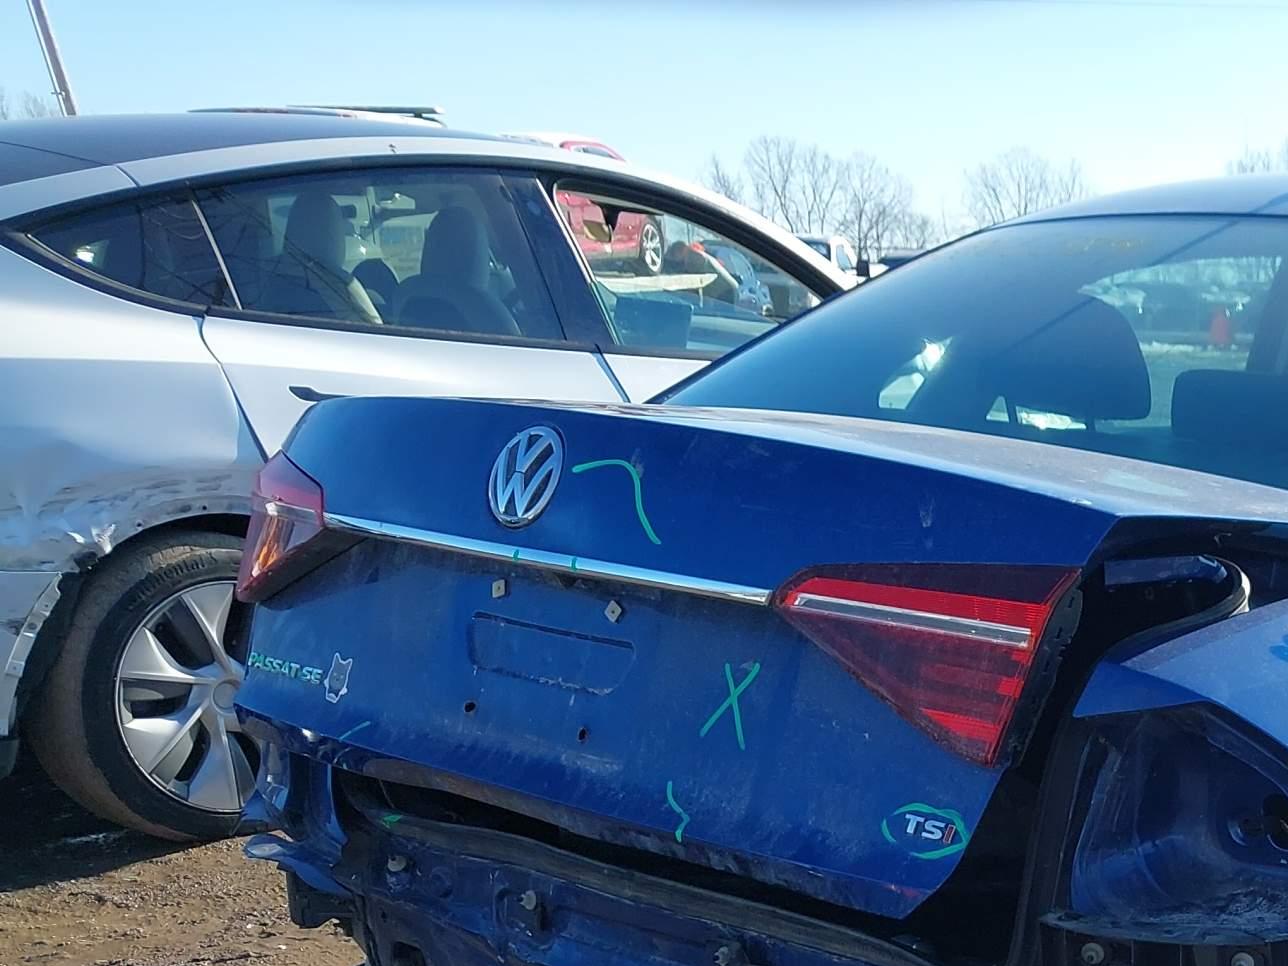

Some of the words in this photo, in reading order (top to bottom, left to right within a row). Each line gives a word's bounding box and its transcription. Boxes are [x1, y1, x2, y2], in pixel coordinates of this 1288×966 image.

[492, 427, 561, 524] VW
[248, 652, 300, 678] PASSAT
[302, 667, 323, 684] SE
[904, 813, 956, 844] TSI
